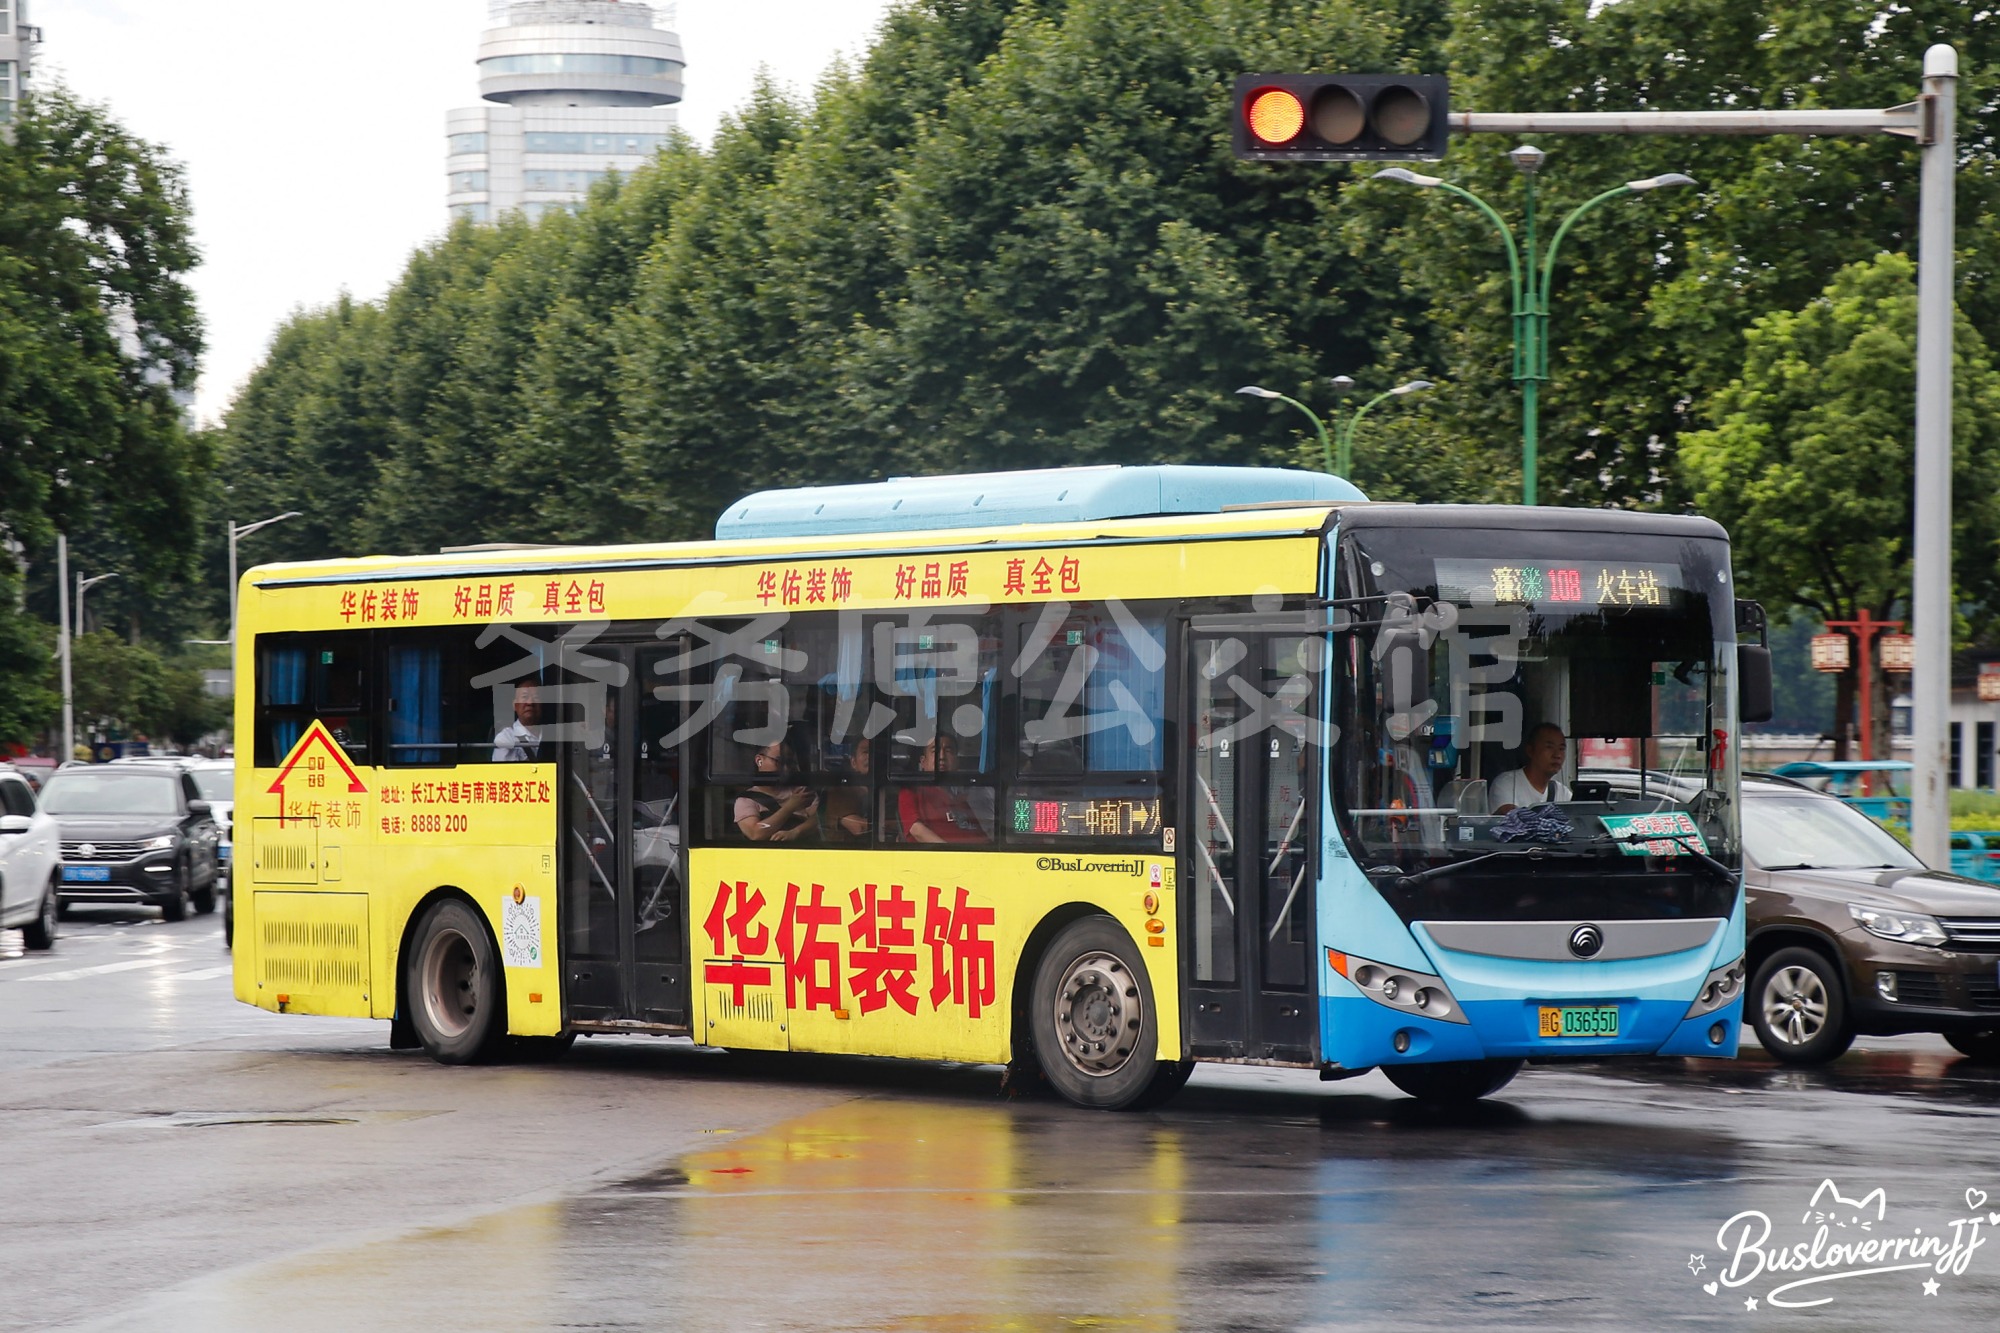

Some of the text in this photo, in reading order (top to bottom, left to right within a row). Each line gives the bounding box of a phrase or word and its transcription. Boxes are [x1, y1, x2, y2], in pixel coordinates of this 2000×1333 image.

[756, 555, 1081, 606] 华佑装饰 好品质 真全包
[1548, 569, 1582, 602] 108
[1597, 568, 1660, 604] 火车站
[340, 579, 606, 623] 华佑装饰 好品质 真全包
[288, 800, 362, 829] 华佑装饰
[445, 814, 468, 833] 200
[1034, 801, 1060, 833] 108
[703, 880, 996, 1019] 华佑装饰
